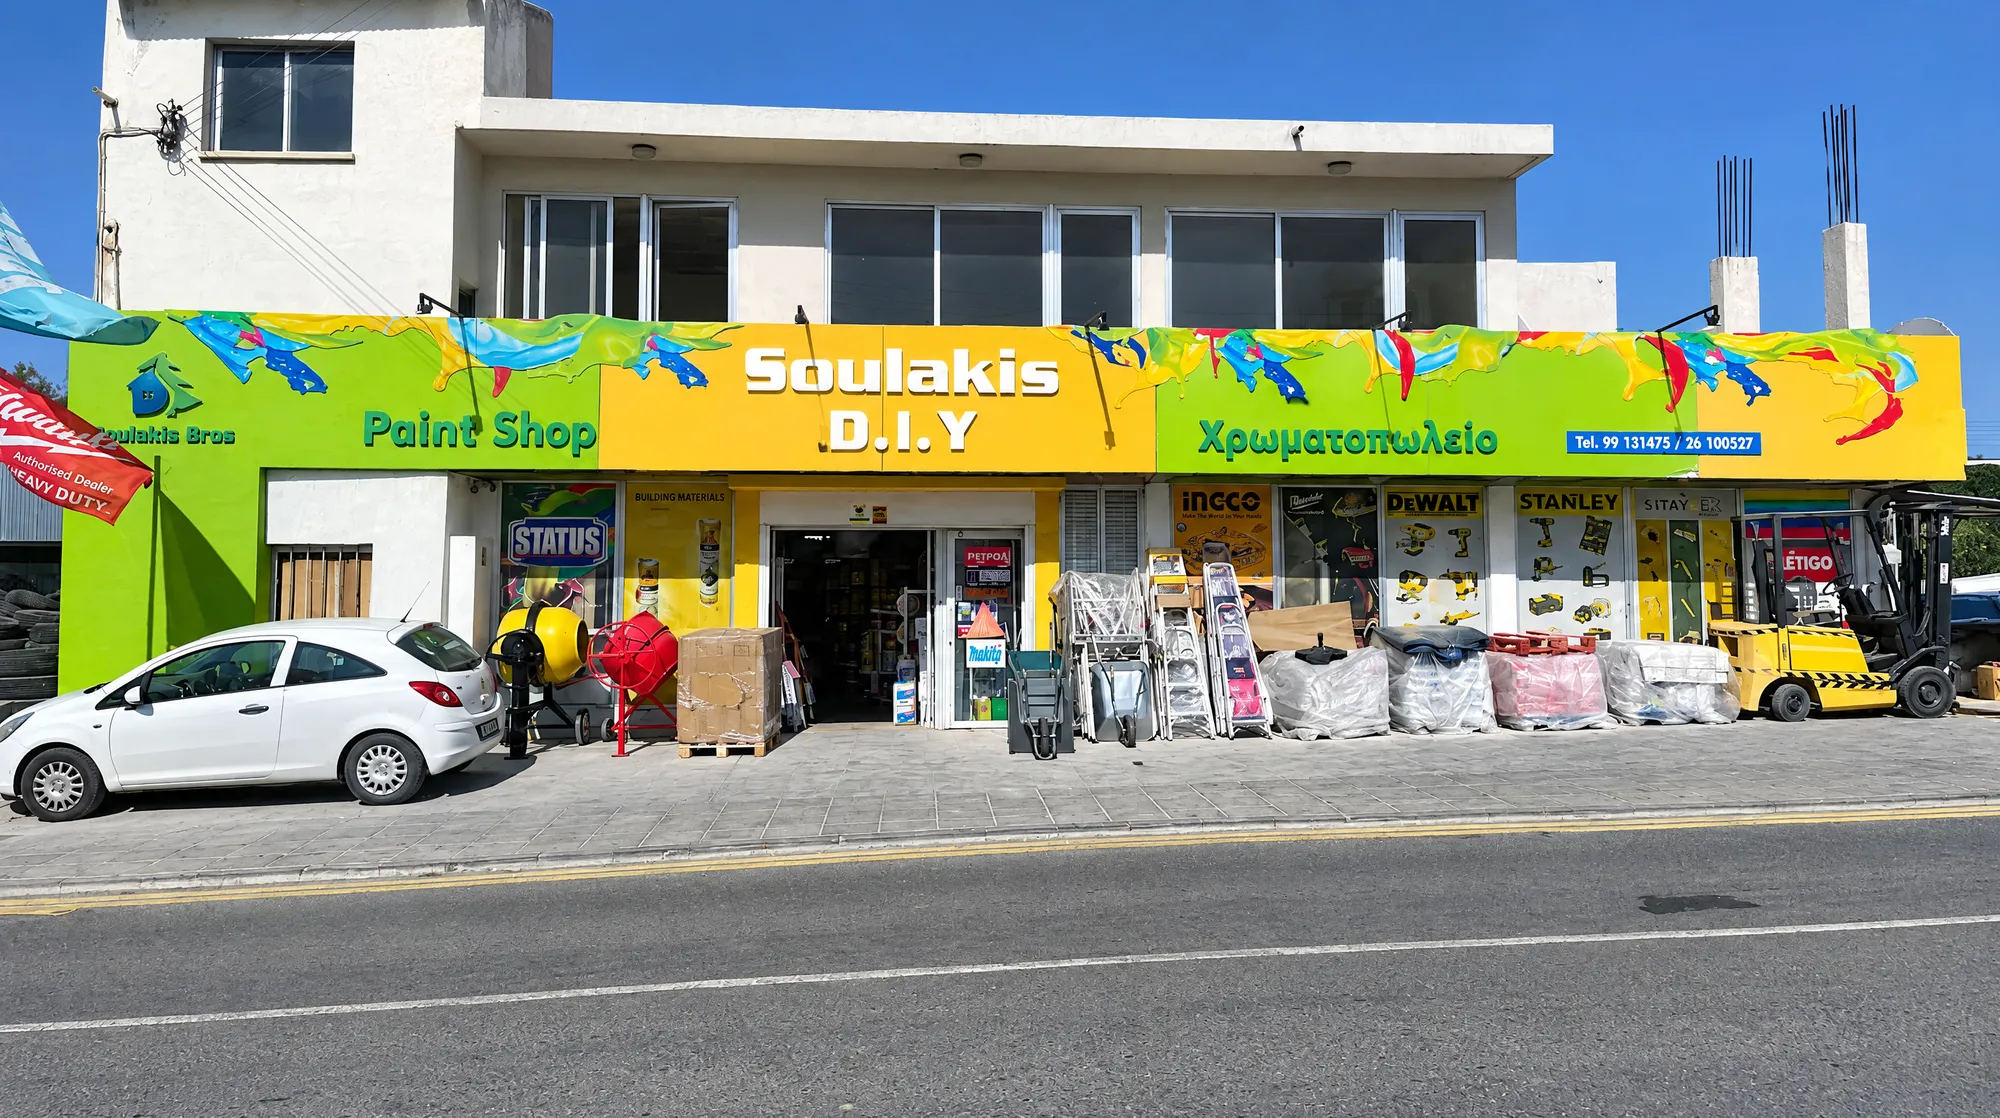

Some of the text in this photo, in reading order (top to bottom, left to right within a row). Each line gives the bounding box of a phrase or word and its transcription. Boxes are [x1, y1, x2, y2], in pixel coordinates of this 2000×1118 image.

[745, 347, 1059, 396] Soulakis
[97, 426, 236, 444] oulakis Bros
[363, 410, 597, 458] Paint Shop
[829, 410, 978, 453] D.I.Y
[1198, 420, 1498, 462] Χρωματοπωλείο
[1575, 435, 1754, 450] Tel. 99 131475 / 26 100527
[13, 451, 114, 495] Authorised Dealer
[635, 493, 725, 502] BUILDING MATERIALS
[1520, 493, 1619, 510] STANLEY
[515, 526, 601, 555] STATUS
